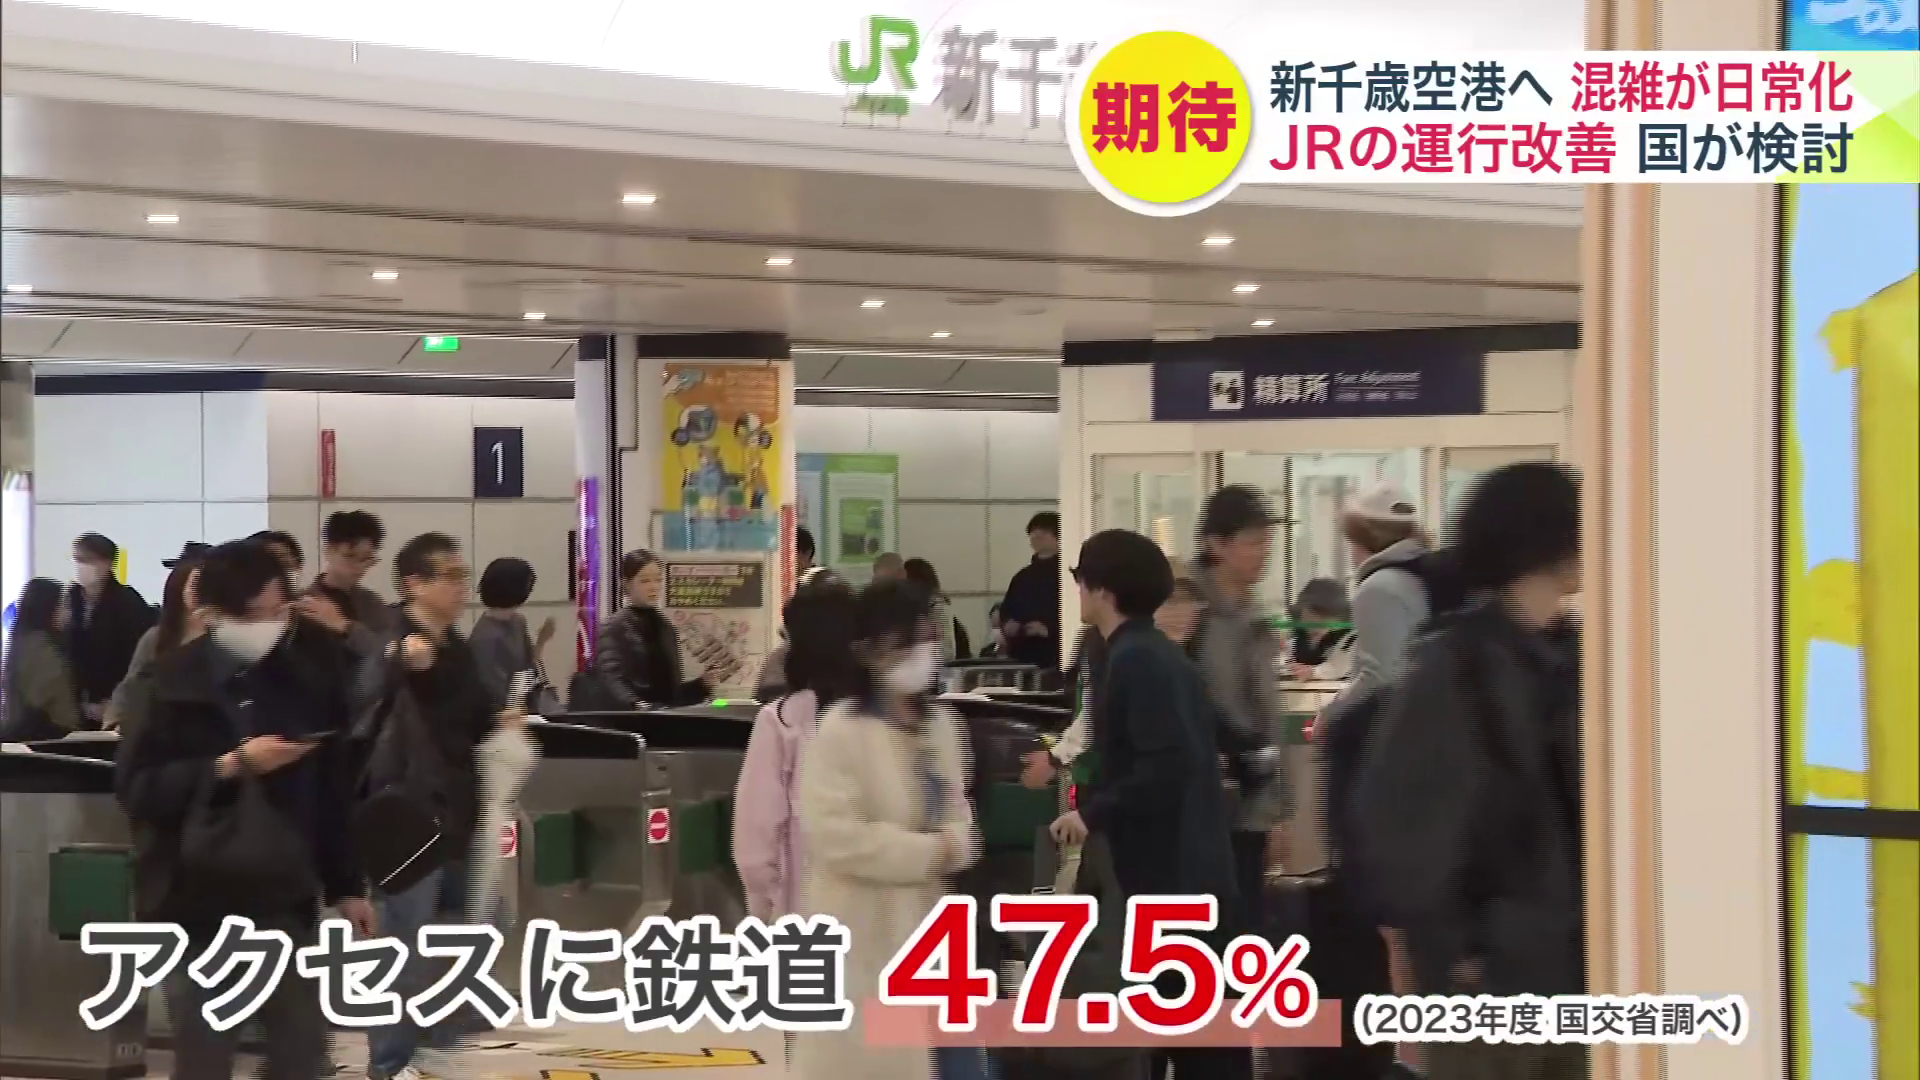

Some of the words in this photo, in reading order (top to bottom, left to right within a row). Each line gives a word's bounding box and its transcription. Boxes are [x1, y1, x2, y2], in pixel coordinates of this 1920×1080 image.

[830, 14, 919, 90] JR
[932, 25, 1098, 130] 新千
[1251, 372, 1330, 405] 精算所
[490, 441, 504, 485] 1
